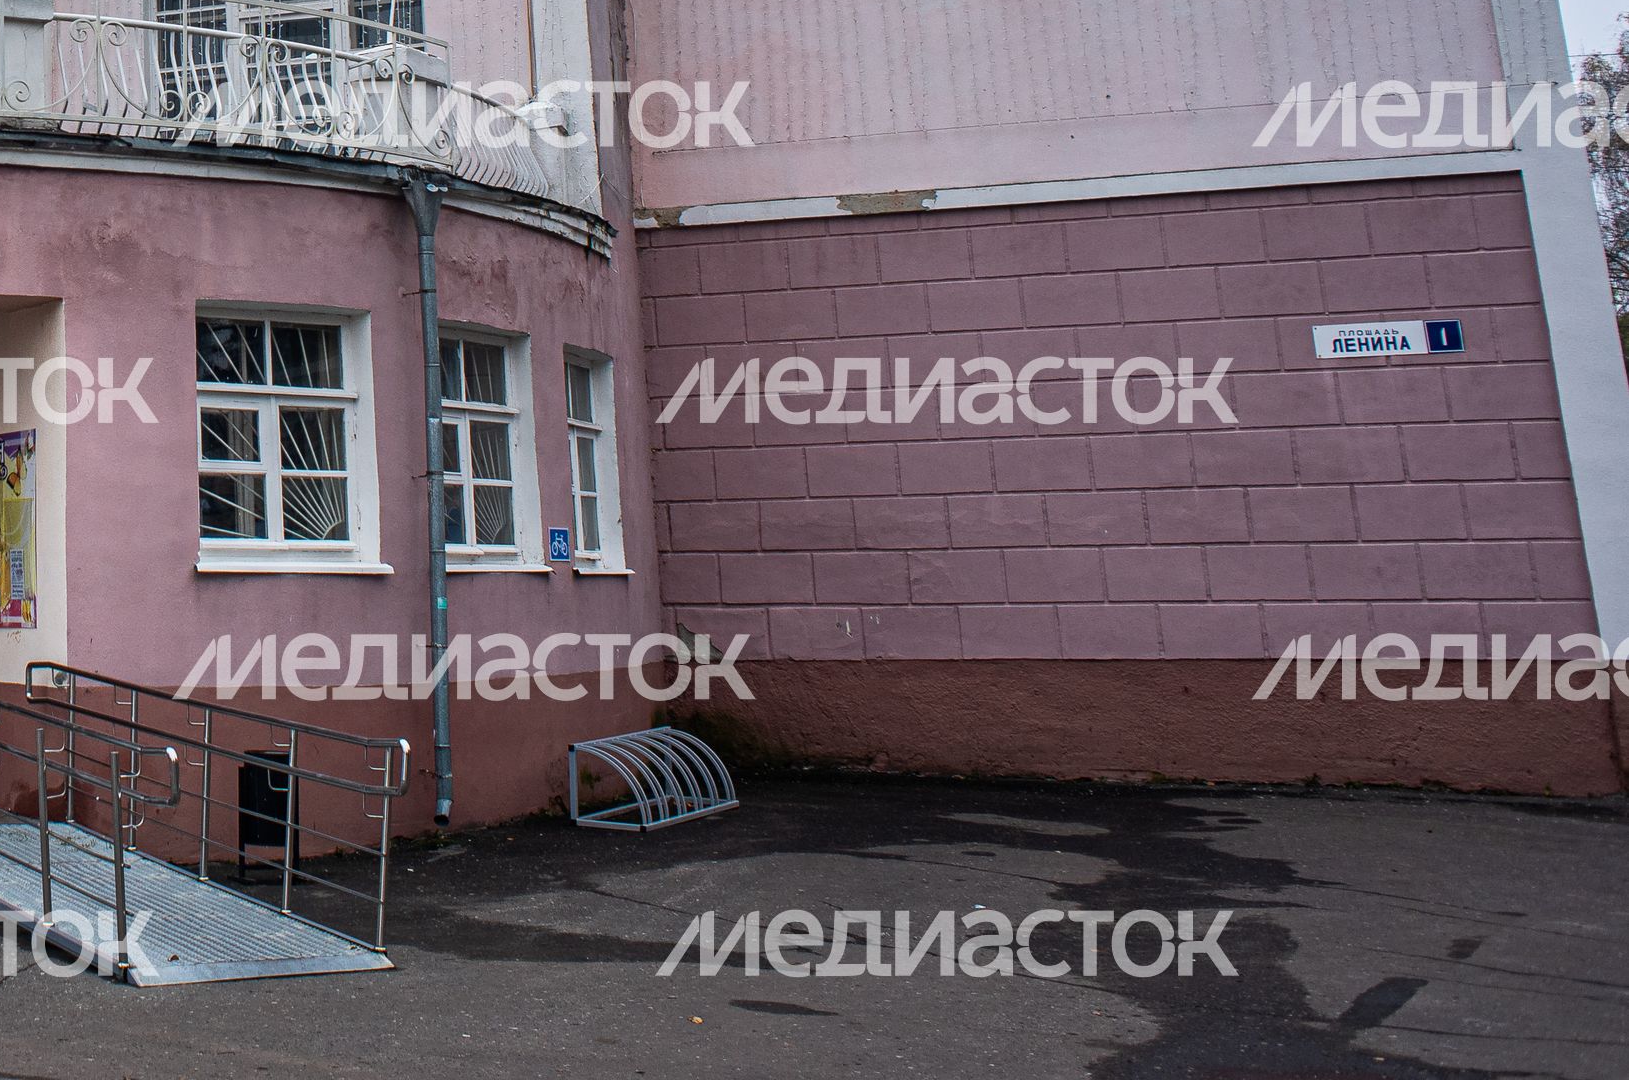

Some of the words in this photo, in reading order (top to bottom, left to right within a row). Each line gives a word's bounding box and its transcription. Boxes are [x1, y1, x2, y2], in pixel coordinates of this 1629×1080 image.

[1338, 328, 1400, 337] ПЛОЩАДЬ
[1439, 327, 1448, 346] 1
[1332, 335, 1412, 353] ЛЕНИНА
